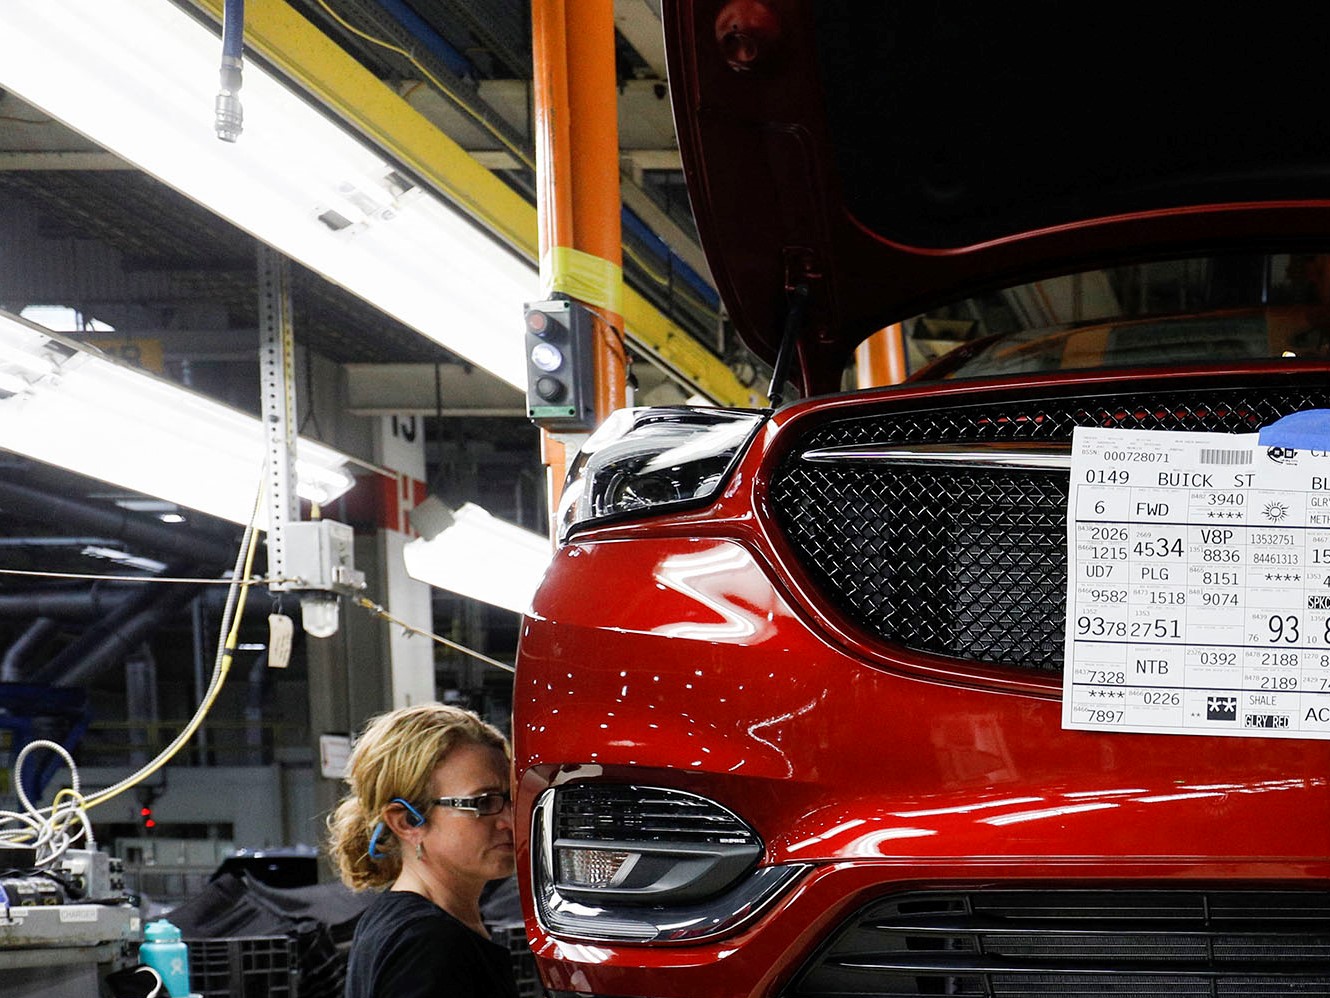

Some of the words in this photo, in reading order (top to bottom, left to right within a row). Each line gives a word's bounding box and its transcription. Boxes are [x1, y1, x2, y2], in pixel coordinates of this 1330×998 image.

[1104, 451, 1169, 463] 000728071
[1086, 469, 1129, 484] 0149
[1158, 472, 1213, 488] BUICK
[1234, 474, 1255, 487] ST
[1208, 494, 1244, 506] 3940
[1095, 500, 1105, 514] 6
[1136, 502, 1169, 516] FWD
[1091, 527, 1128, 540] 2026
[1201, 529, 1233, 544] V8P
[1251, 534, 1294, 544] 13532751
[1092, 547, 1127, 559] 1215
[1133, 537, 1184, 557] 4534
[1203, 549, 1240, 562] 8836
[1253, 553, 1298, 564] 84461313
[1086, 566, 1113, 577] UD7
[1142, 567, 1169, 580] PLG
[1203, 572, 1239, 585] 8151
[1091, 590, 1127, 603] 9582
[1150, 592, 1185, 604] 1518
[1203, 593, 1238, 605] 9074
[1078, 616, 1126, 636] 9378
[1131, 619, 1181, 638] 2751
[1269, 615, 1299, 643] 93
[1201, 652, 1236, 665] 0392
[1262, 653, 1298, 666] 2188
[1136, 660, 1168, 674] NTB
[1088, 671, 1125, 684] 7328
[1261, 677, 1297, 689] 2189
[1144, 692, 1180, 705] 0226
[1250, 695, 1276, 705] SHALE
[1087, 710, 1123, 722] 7897
[1245, 715, 1268, 727] GLRY
[1273, 716, 1289, 728] RED
